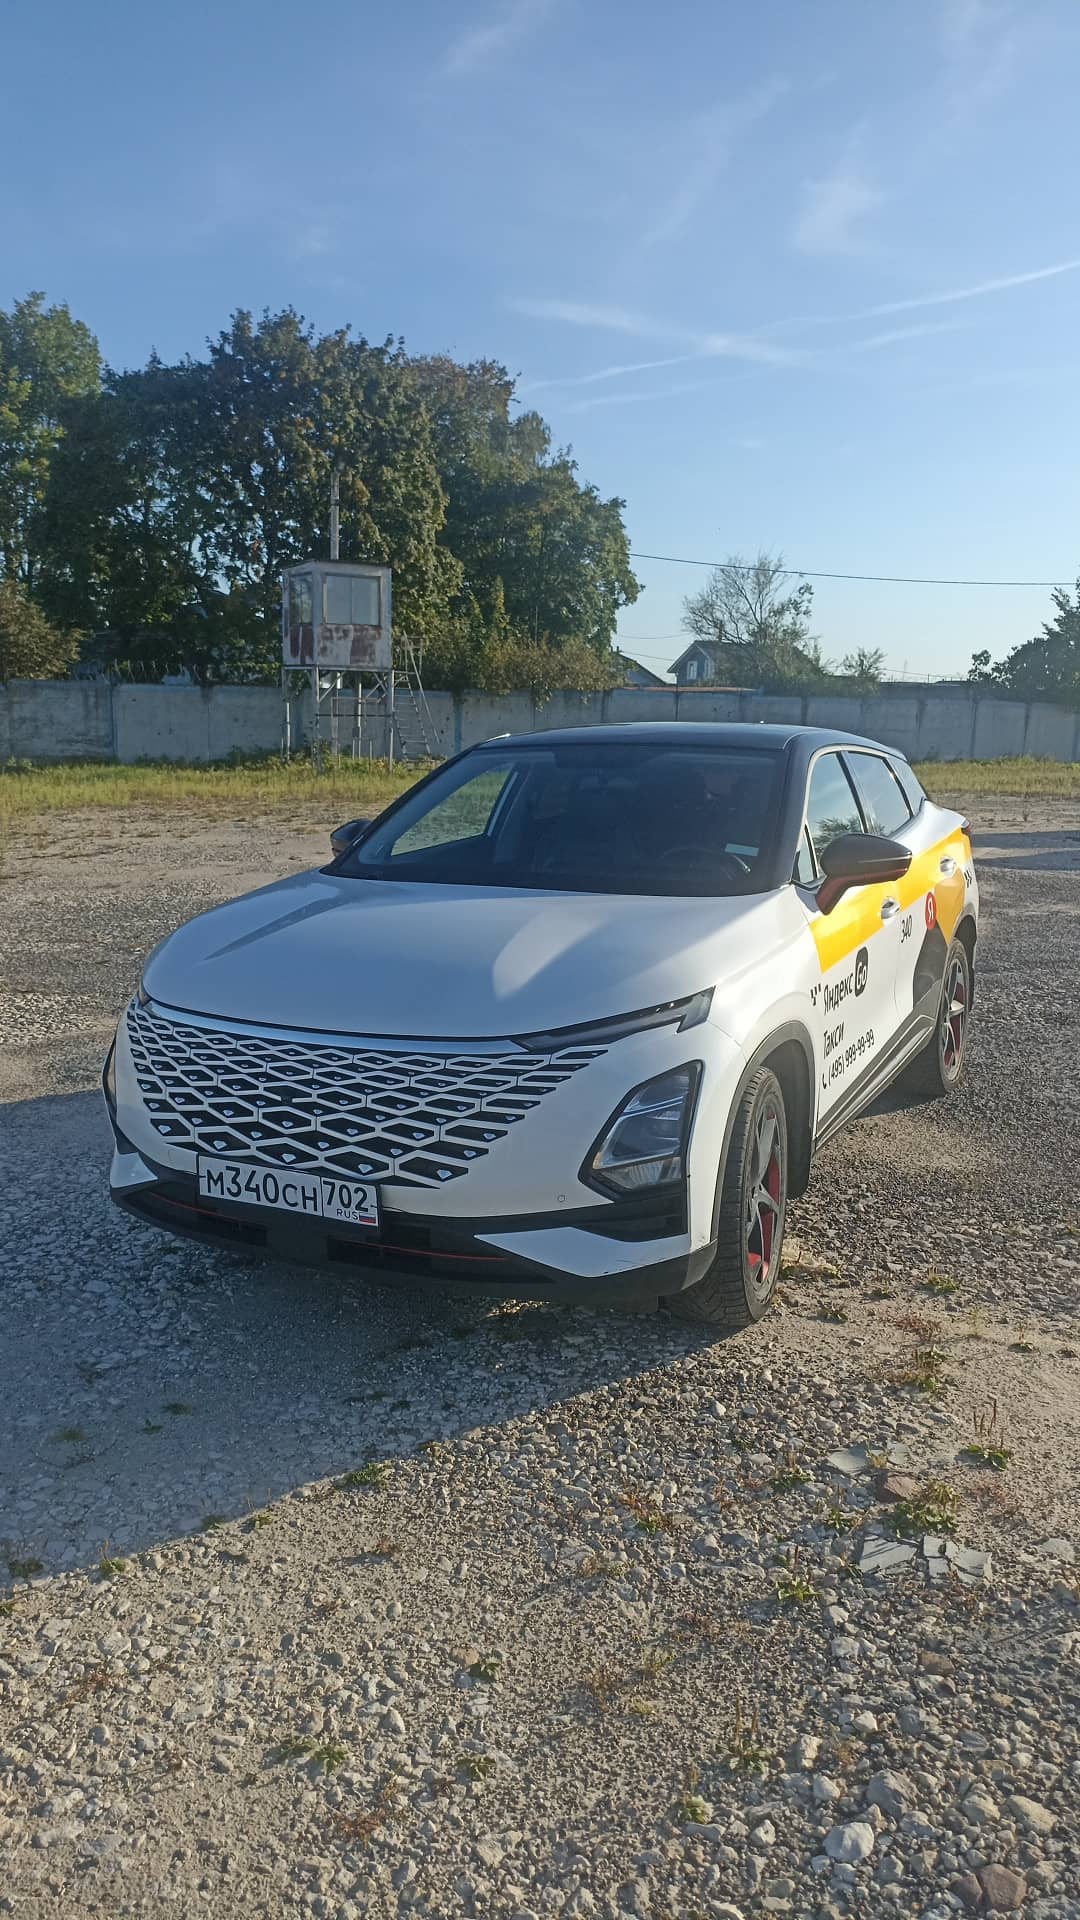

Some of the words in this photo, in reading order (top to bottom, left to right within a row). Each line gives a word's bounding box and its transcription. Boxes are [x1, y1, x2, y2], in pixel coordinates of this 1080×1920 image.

[901, 914, 913, 943] 340
[823, 972, 854, 1016] Яндекс
[856, 961, 868, 990] Go
[823, 1021, 845, 1060] Такси
[828, 1054, 845, 1087] (495)
[845, 1029, 875, 1068] 999-99-99
[206, 1166, 318, 1212] М340СН
[323, 1181, 369, 1213] 702
[336, 1208, 358, 1220] RUS
